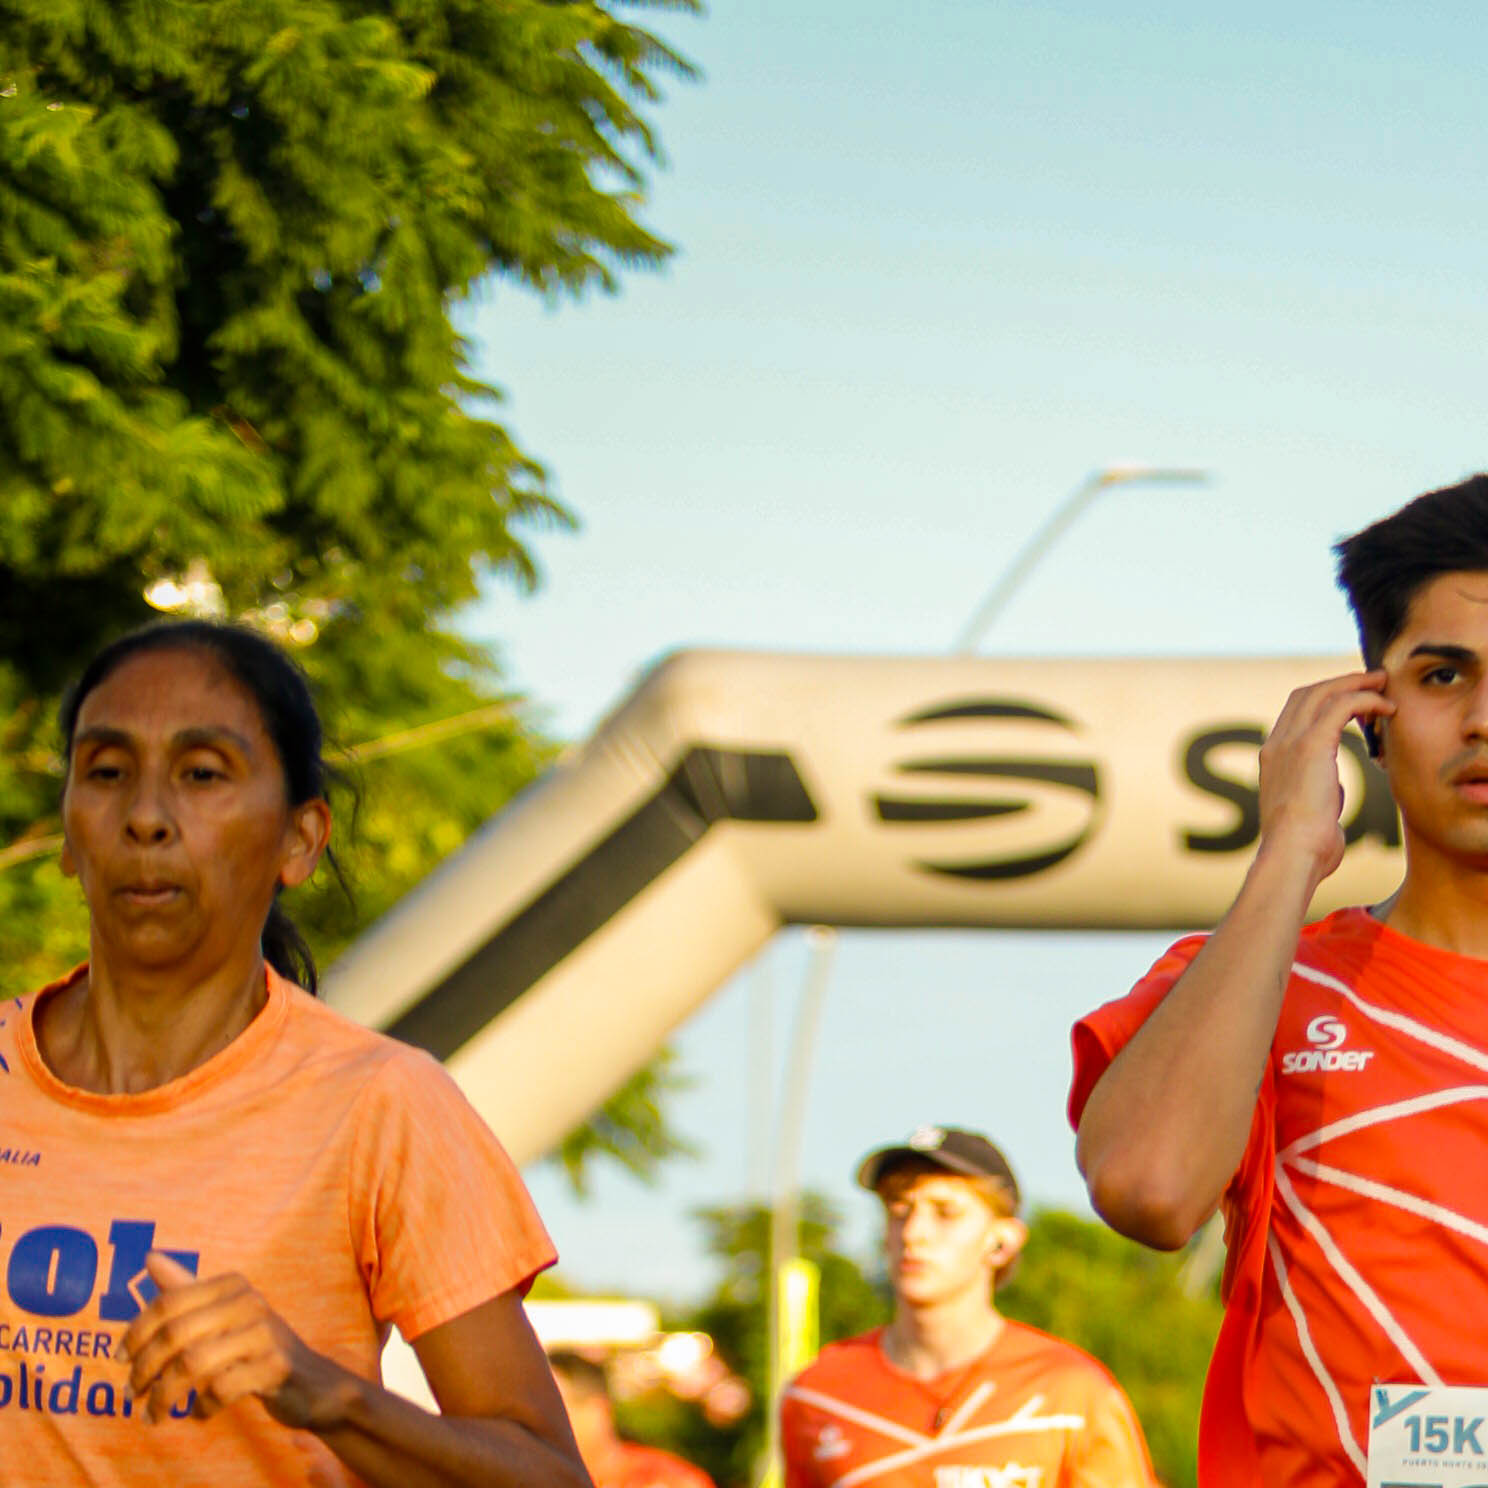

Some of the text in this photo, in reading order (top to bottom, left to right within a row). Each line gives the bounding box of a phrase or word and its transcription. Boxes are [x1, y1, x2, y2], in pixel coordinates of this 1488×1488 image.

[0, 1148, 41, 1166] ALIA
[0, 1220, 200, 1321] ok
[0, 1323, 115, 1360] CARRER
[1403, 1415, 1485, 1455] 15K
